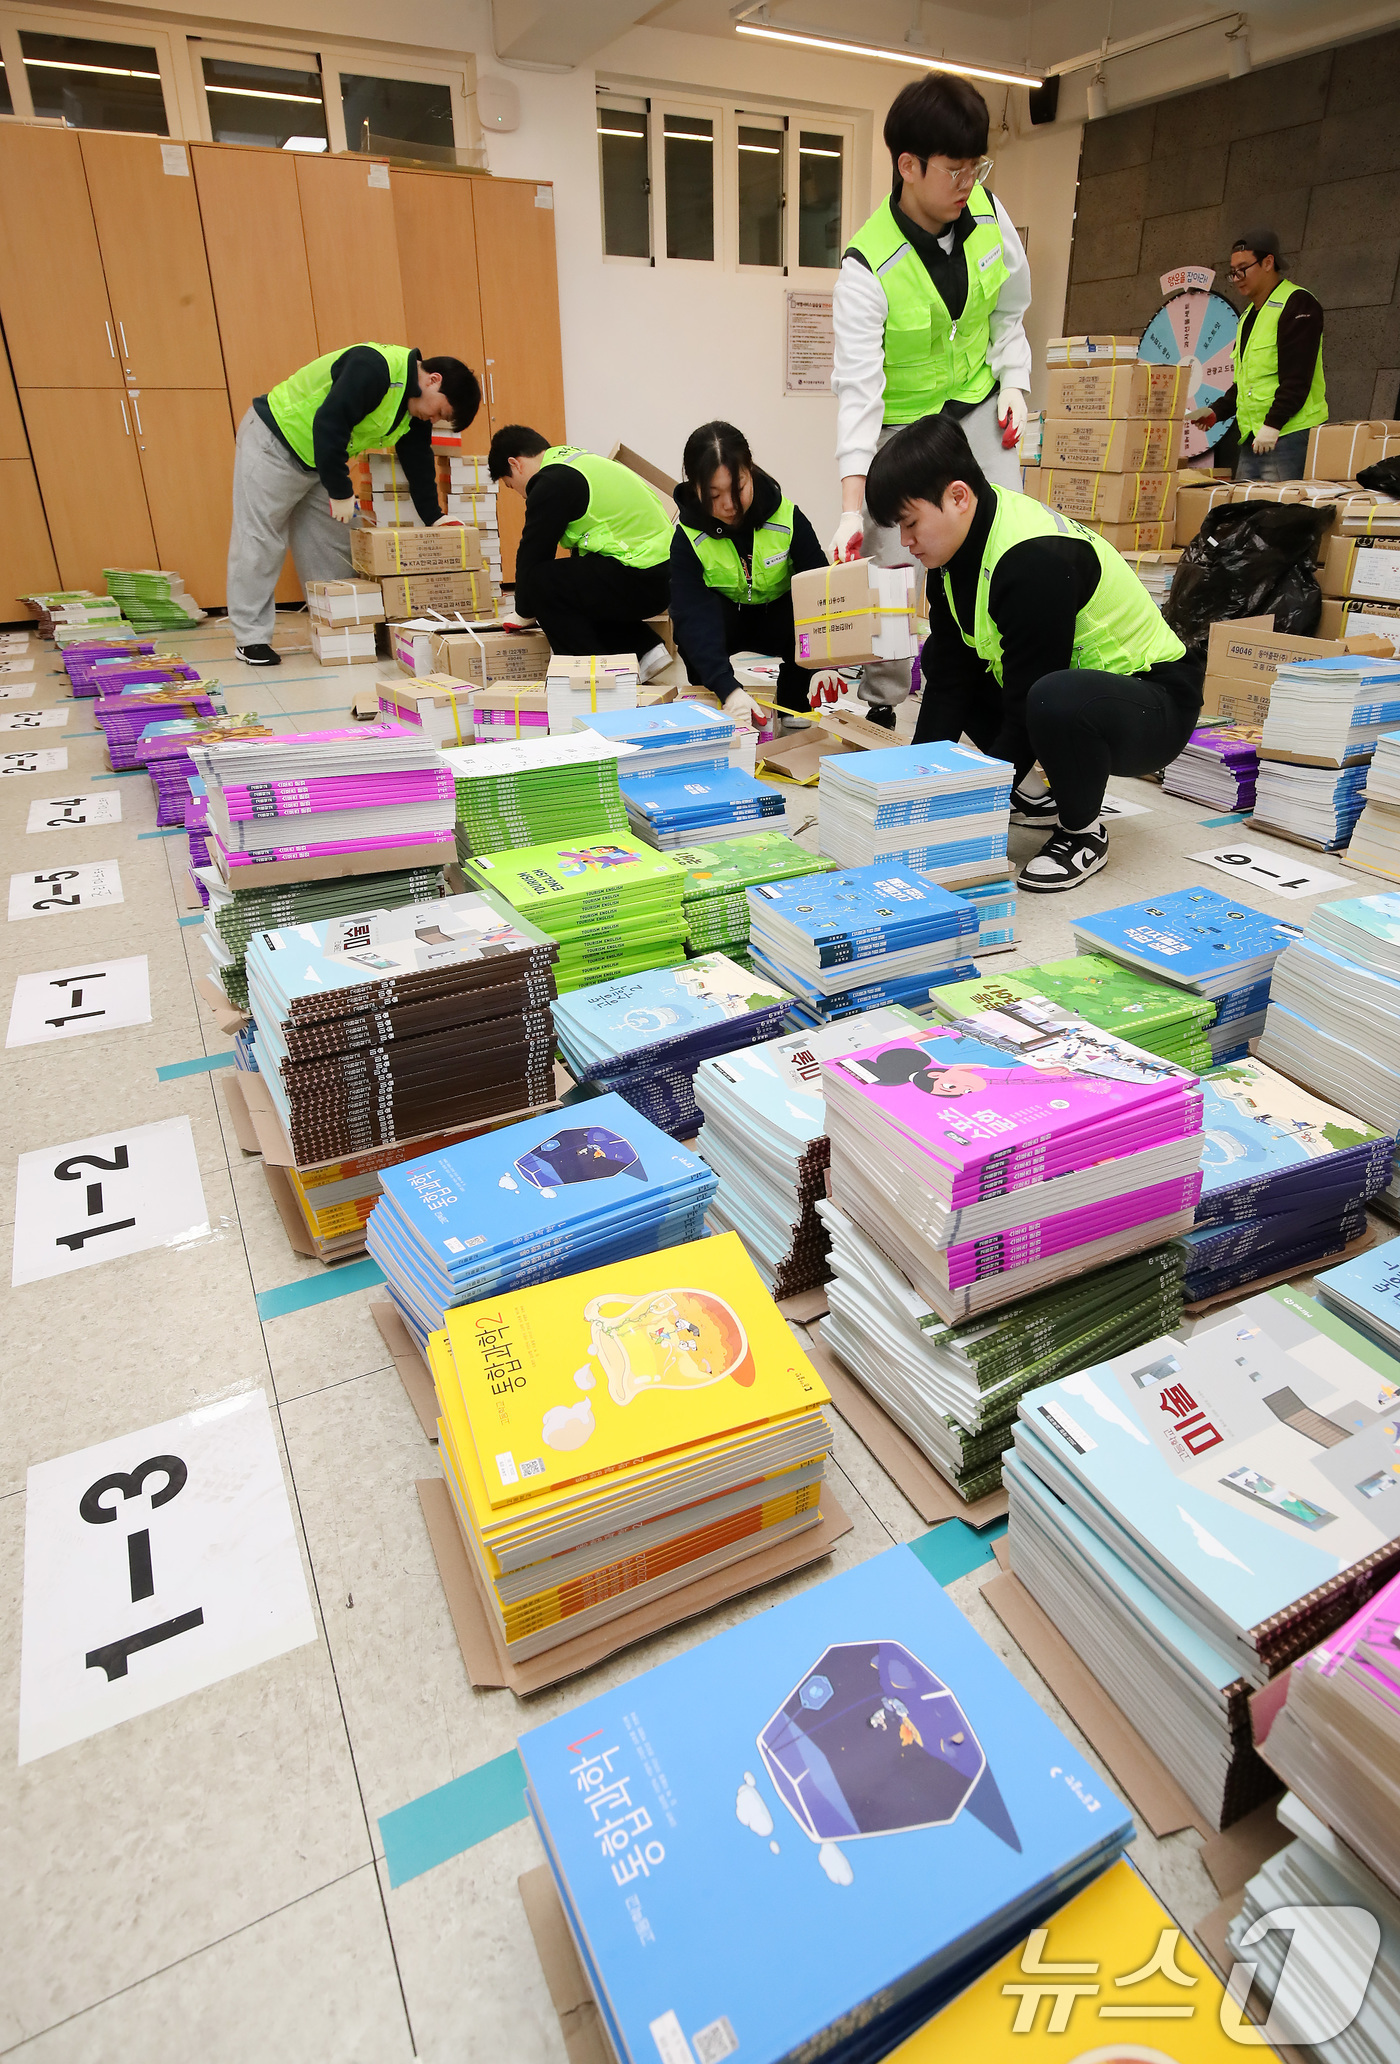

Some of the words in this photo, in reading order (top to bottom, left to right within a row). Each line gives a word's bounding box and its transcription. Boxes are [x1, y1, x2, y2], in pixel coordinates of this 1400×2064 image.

[1231, 646, 1252, 656] 49046
[47, 799, 87, 826] 2-4
[33, 870, 81, 910] 2-5
[517, 872, 549, 895] TOURISM
[532, 868, 564, 892] ENGLISH
[343, 925, 370, 951] 미술
[45, 972, 106, 1028] 1-1
[937, 1107, 998, 1139] 스포츠
[971, 1109, 1018, 1134] 문화
[56, 1145, 136, 1251] 1-2
[1159, 1382, 1224, 1457] 미술
[79, 1455, 205, 1682] 1-3
